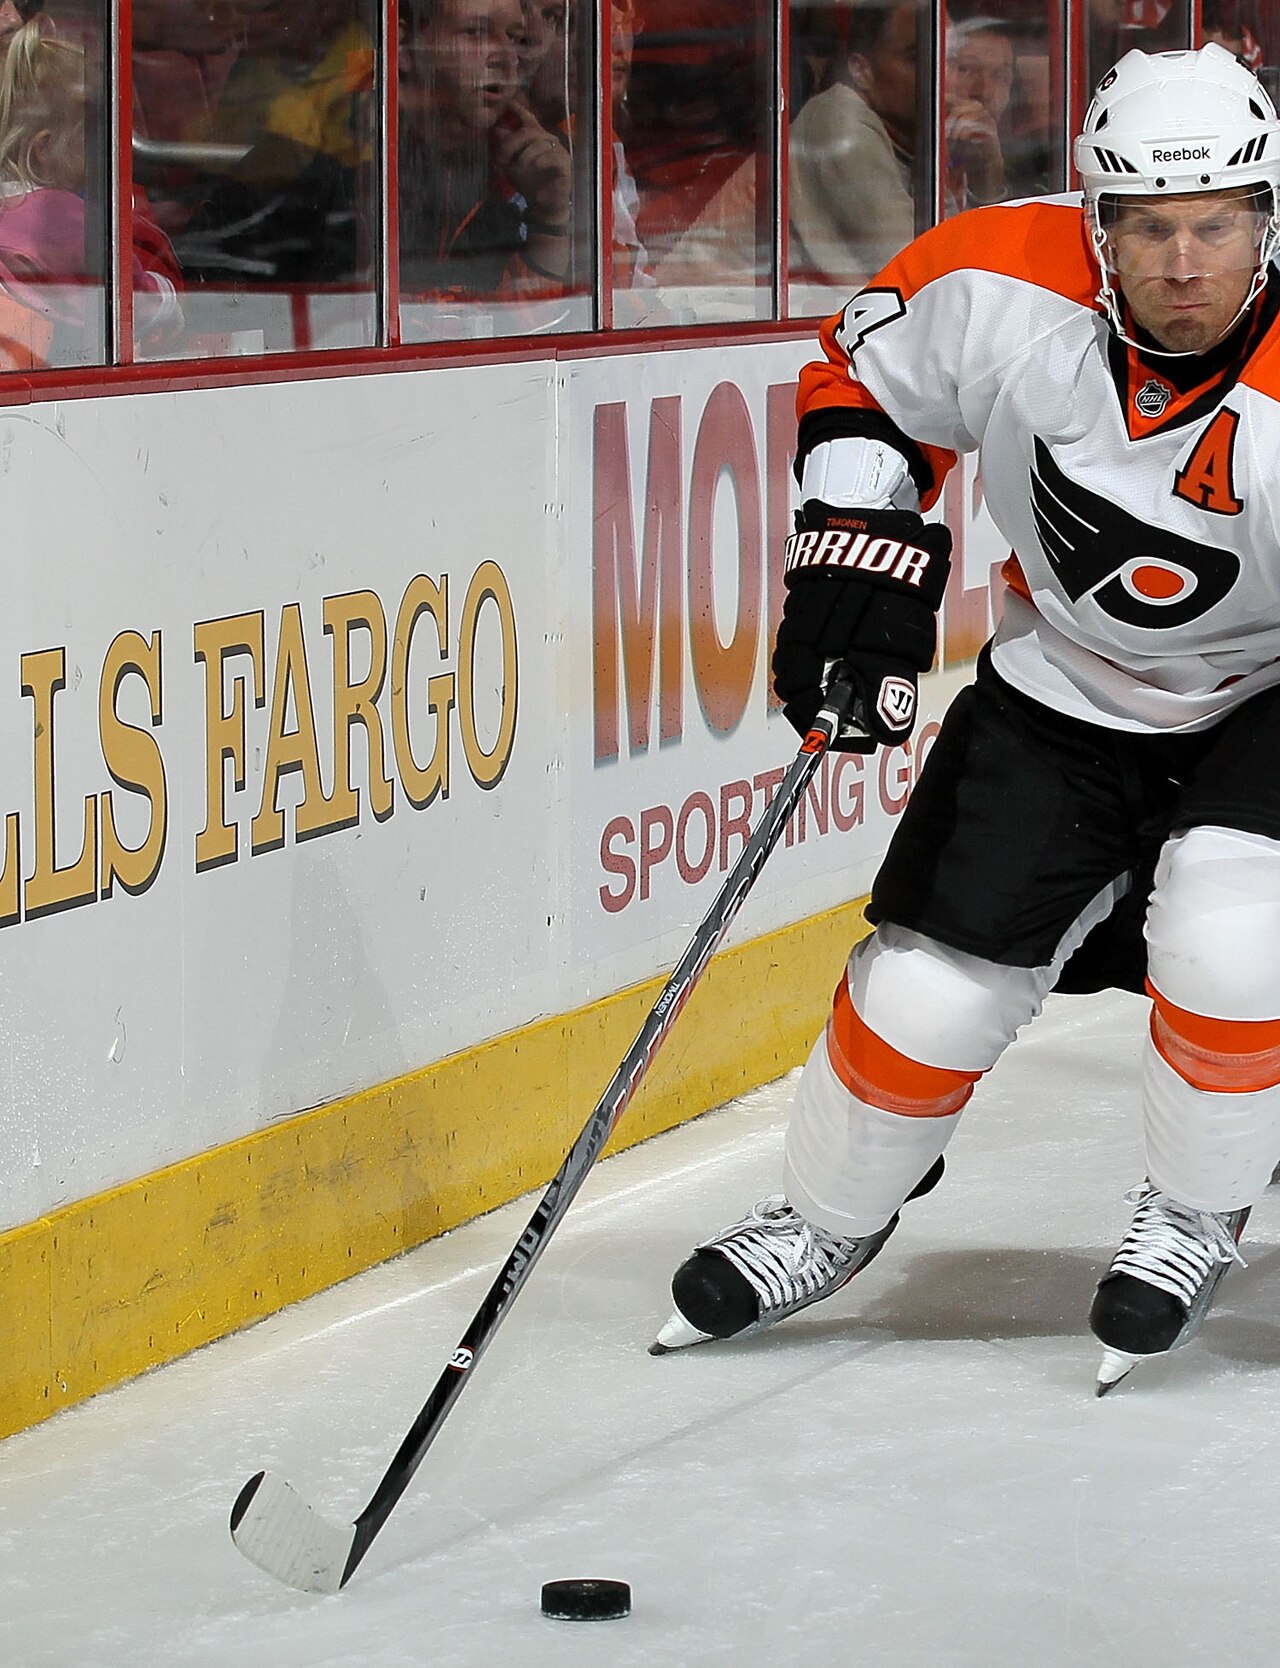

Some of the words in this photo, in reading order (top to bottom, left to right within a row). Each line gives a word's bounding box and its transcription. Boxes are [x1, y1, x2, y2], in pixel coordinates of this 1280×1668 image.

[1152, 146, 1211, 163] Reebok
[1141, 394, 1163, 403] NHL
[1171, 404, 1245, 517] A
[825, 517, 868, 531] TIMONEN
[0, 629, 168, 929] LS
[193, 559, 519, 875] FARGO
[654, 981, 681, 1018] TIMONEN
